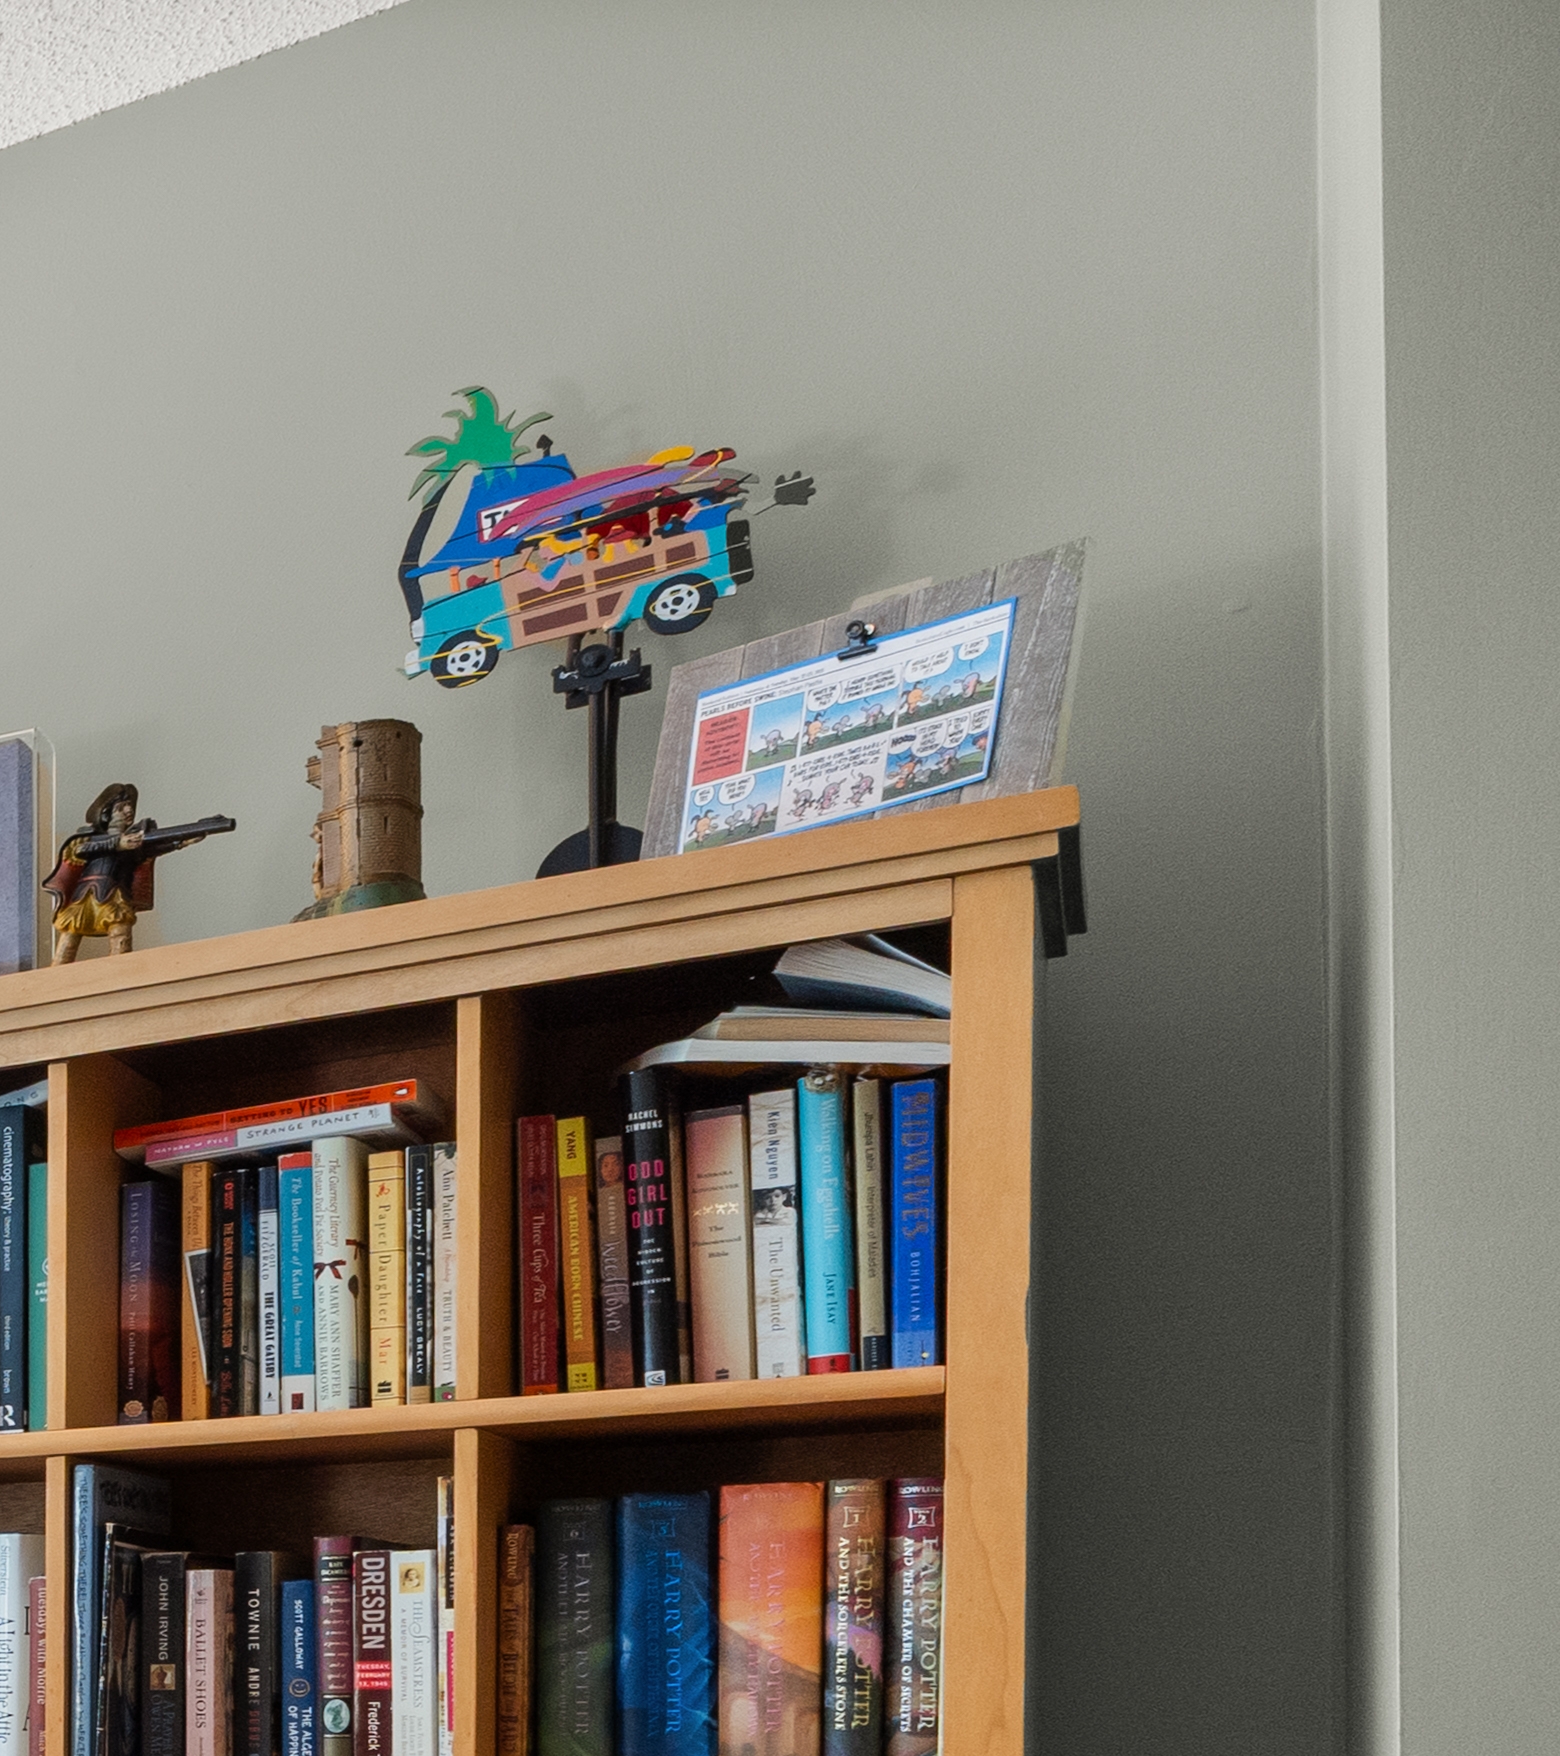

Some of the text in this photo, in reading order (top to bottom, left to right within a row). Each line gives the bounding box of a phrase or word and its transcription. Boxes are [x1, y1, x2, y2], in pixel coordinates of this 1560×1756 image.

[246, 1112, 359, 1140] STRANGE PLANET
[298, 1096, 327, 1117] YES
[625, 1119, 663, 1133] SIMMONS
[628, 1109, 659, 1122] RACHEL
[0, 1126, 14, 1215] cinematography:
[566, 1130, 576, 1160] YANG
[628, 1159, 664, 1182] ODD
[767, 1110, 780, 1181] Kien Nguyen
[442, 1168, 454, 1187] Ann
[627, 1186, 668, 1206] GIRL
[292, 1197, 303, 1300] Bookseller Kabul
[631, 1208, 666, 1229] OUT
[375, 1204, 391, 1323] Paper Daughter
[569, 1195, 584, 1342] AMERICAN BORN CHINESE
[329, 1284, 341, 1398] MARY SHAFFER
[379, 1337, 391, 1365] Mar
[442, 1290, 452, 1373] TRUTH BEAUTY
[4, 1370, 12, 1394] brown
[362, 1558, 385, 1650] DRESDEN
[854, 1536, 874, 1627] HARRY
[158, 1576, 168, 1661] JOHN IRVING
[248, 1588, 260, 1652] TOWNIE
[293, 1599, 303, 1670] SCOTT GALLOWAY
[665, 1550, 683, 1736] HARRY POTTER
[917, 1536, 939, 1731] HARRY POTTER
[195, 1619, 206, 1729] BALLET SHOES
[288, 1705, 298, 1720] OF
[302, 1706, 312, 1725] THE
[368, 1702, 380, 1750] Frederick
